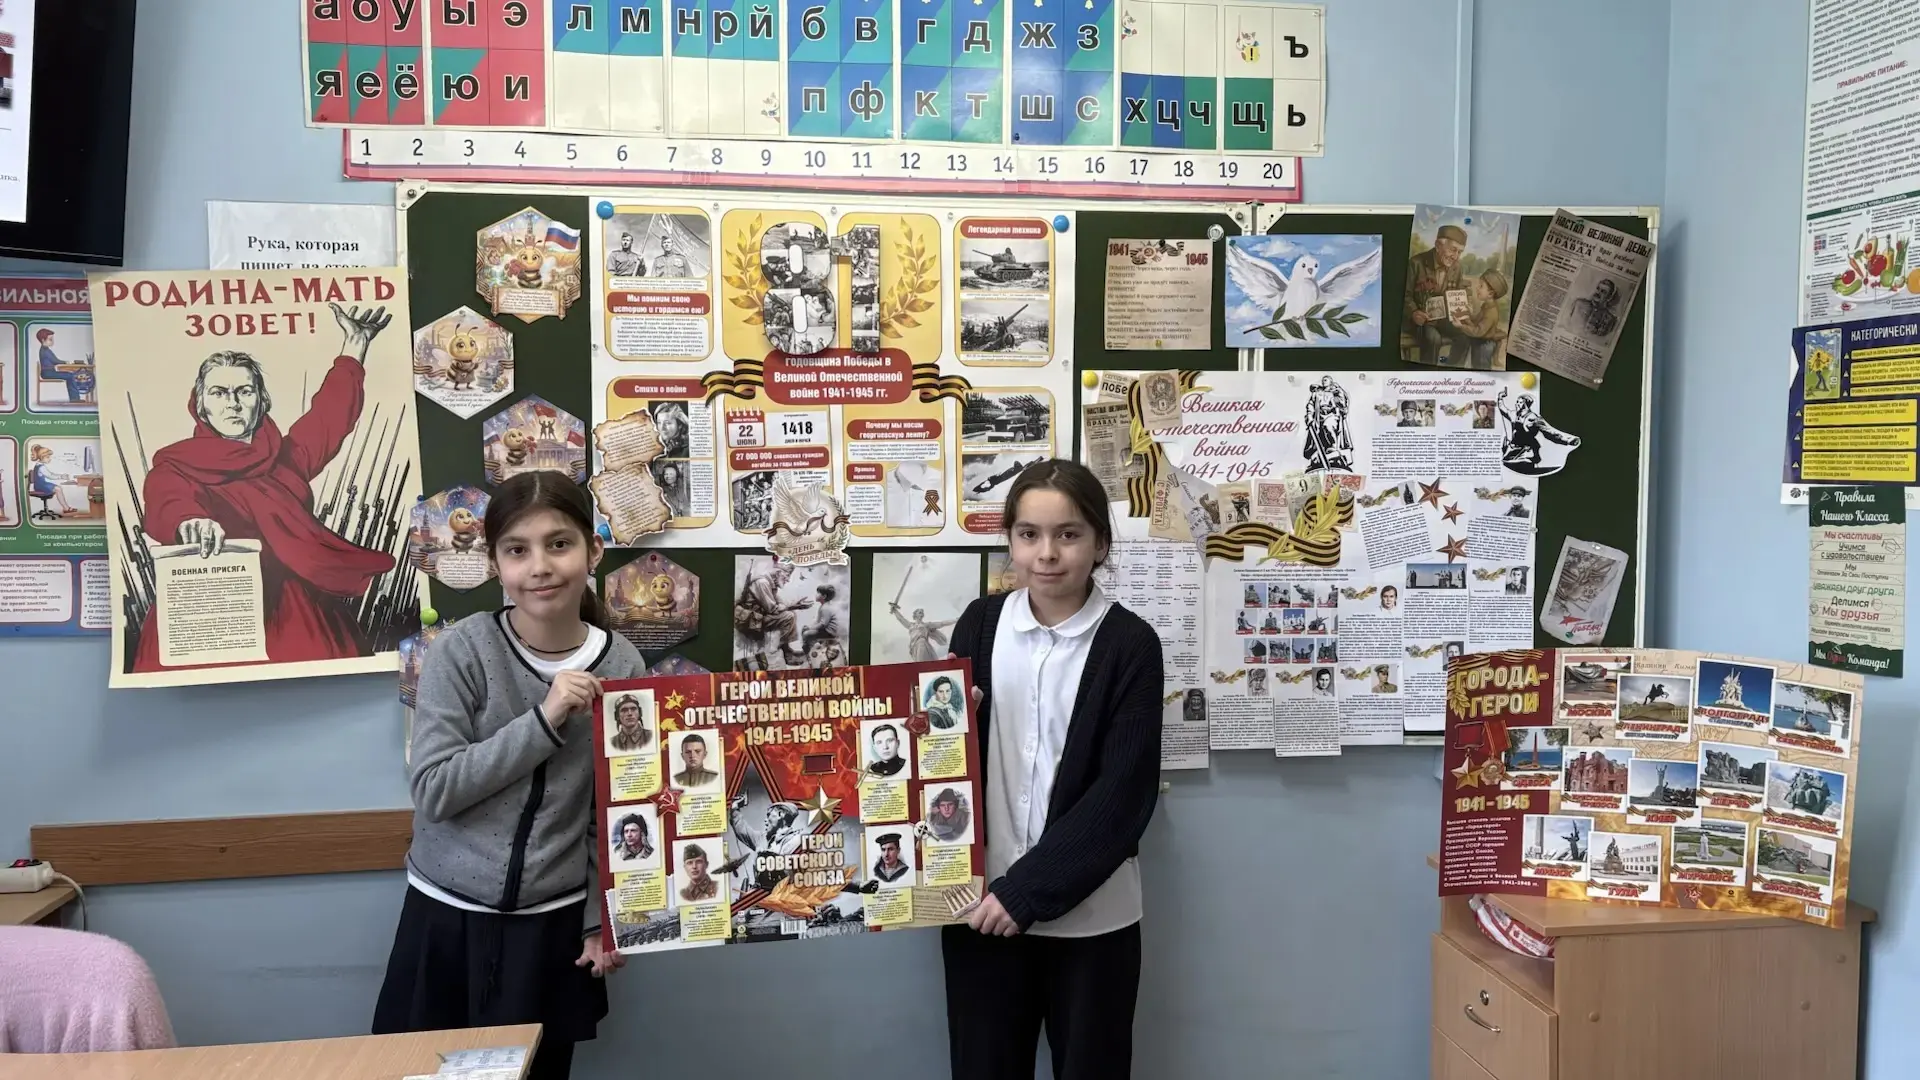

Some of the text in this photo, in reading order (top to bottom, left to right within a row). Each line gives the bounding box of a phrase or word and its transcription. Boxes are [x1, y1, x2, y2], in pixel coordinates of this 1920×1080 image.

[314, 0, 1309, 58] а о у ы э л м н р й б в г д ж з ъ
[1836, 60, 1908, 90] ПРАВИЛЬНОЕ ПИТАНИЕ:
[316, 65, 1306, 132] я е ё ю и п ф к т ш с х ц ч щ ь
[361, 138, 1283, 180] 1 2 3 4 5 6 7 8 9 10 11 12 13 14 15 16 17 18 19 20
[968, 225, 1041, 234] Легендарная техника
[1555, 215, 1652, 258] НАСТАЛ ВЕЛИКИЙ ДЕНЬ!
[247, 235, 359, 254] Рука, которая
[1109, 243, 1130, 256] 1941
[1546, 234, 1592, 257] ПРАВДА
[1185, 253, 1208, 266] 1945
[104, 275, 395, 308] РОДИНА-МАТЬ
[627, 294, 691, 304] Мы помним свою
[613, 306, 648, 314] историю
[655, 306, 690, 315] гордимся
[185, 311, 316, 337] ЗОВЕТ!
[1851, 323, 1918, 341] КАТЕГОРИЧЕСКИ
[785, 355, 891, 368] годовщина Победы в
[774, 371, 903, 383] Великой Отечественной
[1387, 378, 1496, 388] Героические подвиги Великой
[634, 385, 659, 394] Стихи
[667, 385, 687, 394] войне
[790, 387, 888, 399] войне 1941-1945 гг.
[1398, 386, 1456, 395] Отечественной
[1182, 393, 1266, 413] Великая
[738, 425, 753, 437] 22
[781, 421, 813, 436] 1418
[865, 421, 892, 430] Почему
[904, 421, 924, 429] носим
[859, 431, 930, 440] георгиевскую ленту?
[1193, 437, 1251, 458] война
[736, 452, 772, 461] 27 000 000
[1834, 490, 1876, 507] Правила
[1820, 509, 1890, 522] Нашего Класса
[1837, 532, 1883, 541] счастливы
[1838, 543, 1866, 551] Учимся
[1826, 553, 1885, 561] удовольствием
[171, 564, 246, 576] ВОЕННАЯ ПРИСЯГА
[1844, 563, 1857, 571] Мы
[1831, 596, 1870, 608] Делимся
[1822, 607, 1880, 622] Мы друзья
[1814, 648, 1826, 660] Мы
[1847, 653, 1890, 672] Команда!
[1455, 664, 1549, 691] ГОРОДА-
[721, 673, 855, 701] ГЕРОИ ВЕЛИКОЙ
[684, 696, 893, 727] ОТЕЧЕСТВЕННОЙ ВОЙНЫ
[1566, 707, 1612, 717] МОСКВА
[1700, 708, 1769, 725] ВОЛГОГРАД
[745, 723, 833, 746] 1941-1945
[1622, 724, 1682, 734] ЛЕНИНГРАД
[801, 832, 844, 850] ГЕРОИ
[756, 850, 843, 872] СОВЕТСКОГО
[794, 869, 846, 888] СОЮЗА
[1677, 871, 1738, 883] МУРМАНСК
[1607, 887, 1639, 898] ТУЛА
